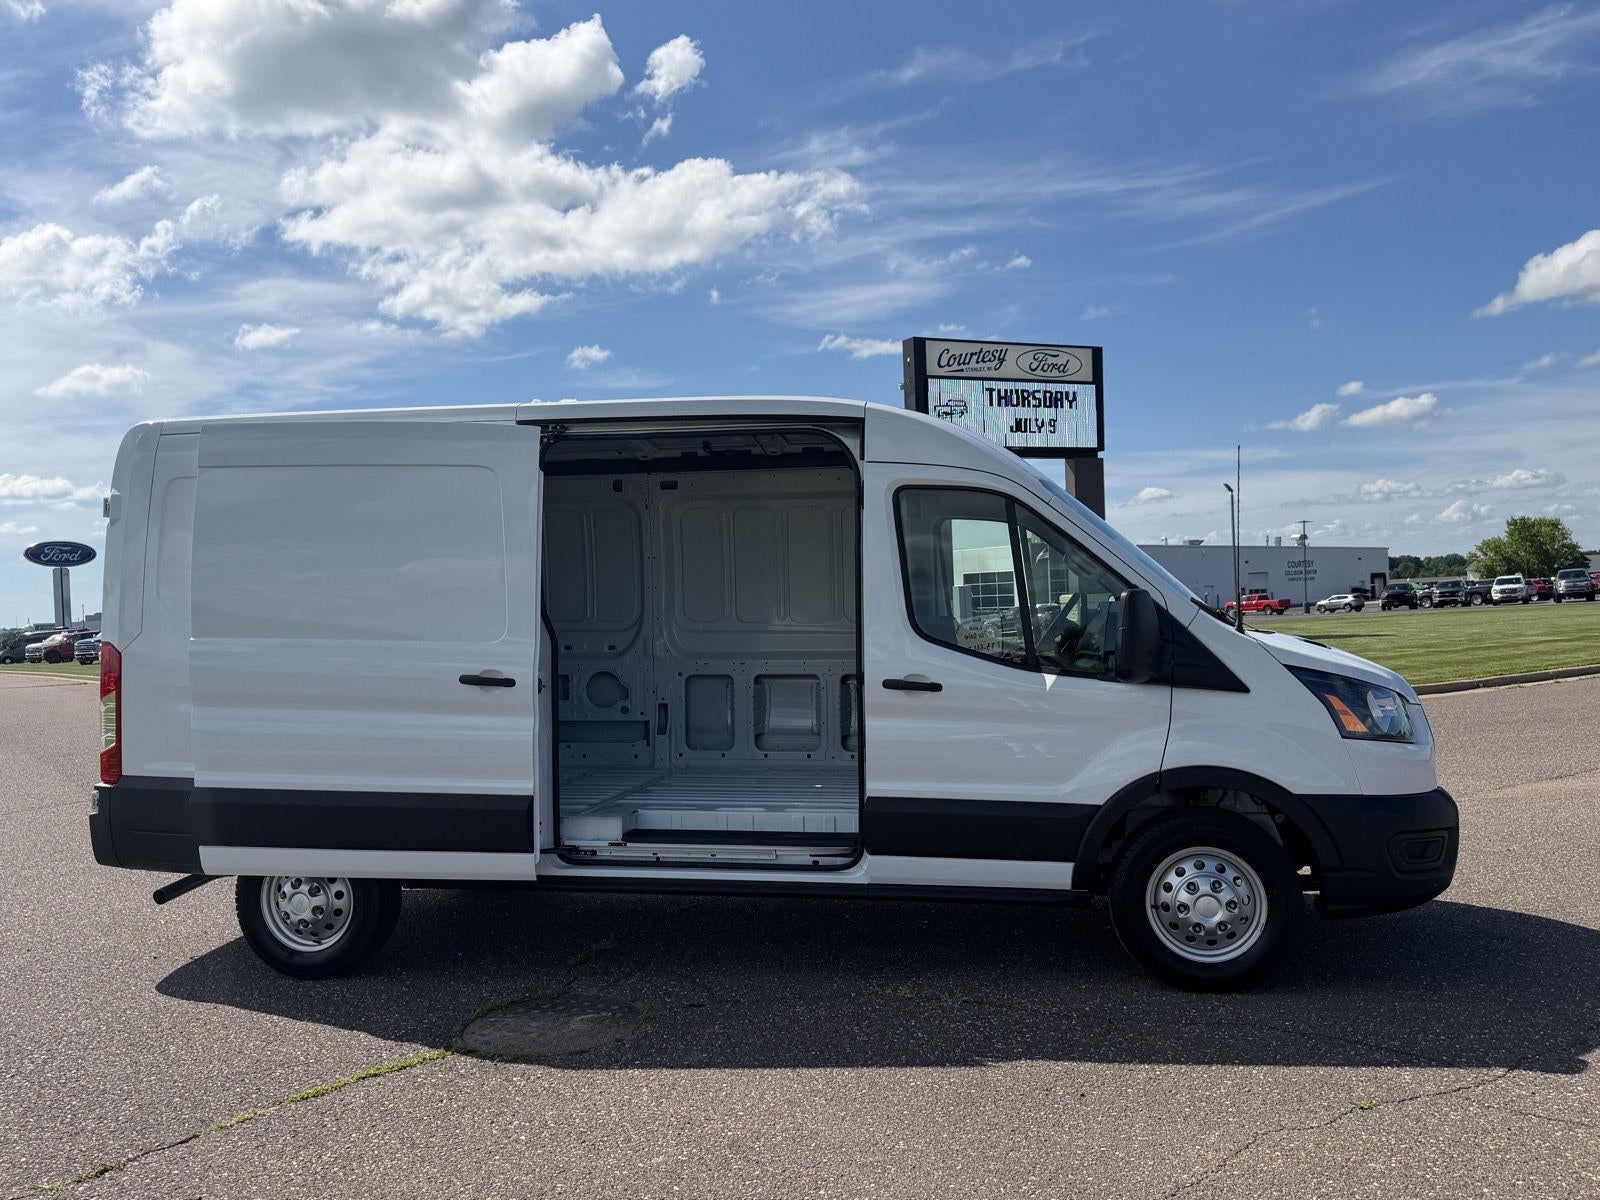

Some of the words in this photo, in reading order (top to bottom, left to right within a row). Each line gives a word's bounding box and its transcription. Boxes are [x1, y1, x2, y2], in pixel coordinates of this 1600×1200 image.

[937, 347, 1008, 371] Courtesy
[1028, 351, 1070, 374] Ford
[985, 387, 1077, 410] THURSDAY
[1010, 417, 1045, 434] JULY
[1049, 418, 1056, 434] 9
[40, 545, 82, 561] Ford
[1287, 560, 1314, 568] COURTESY
